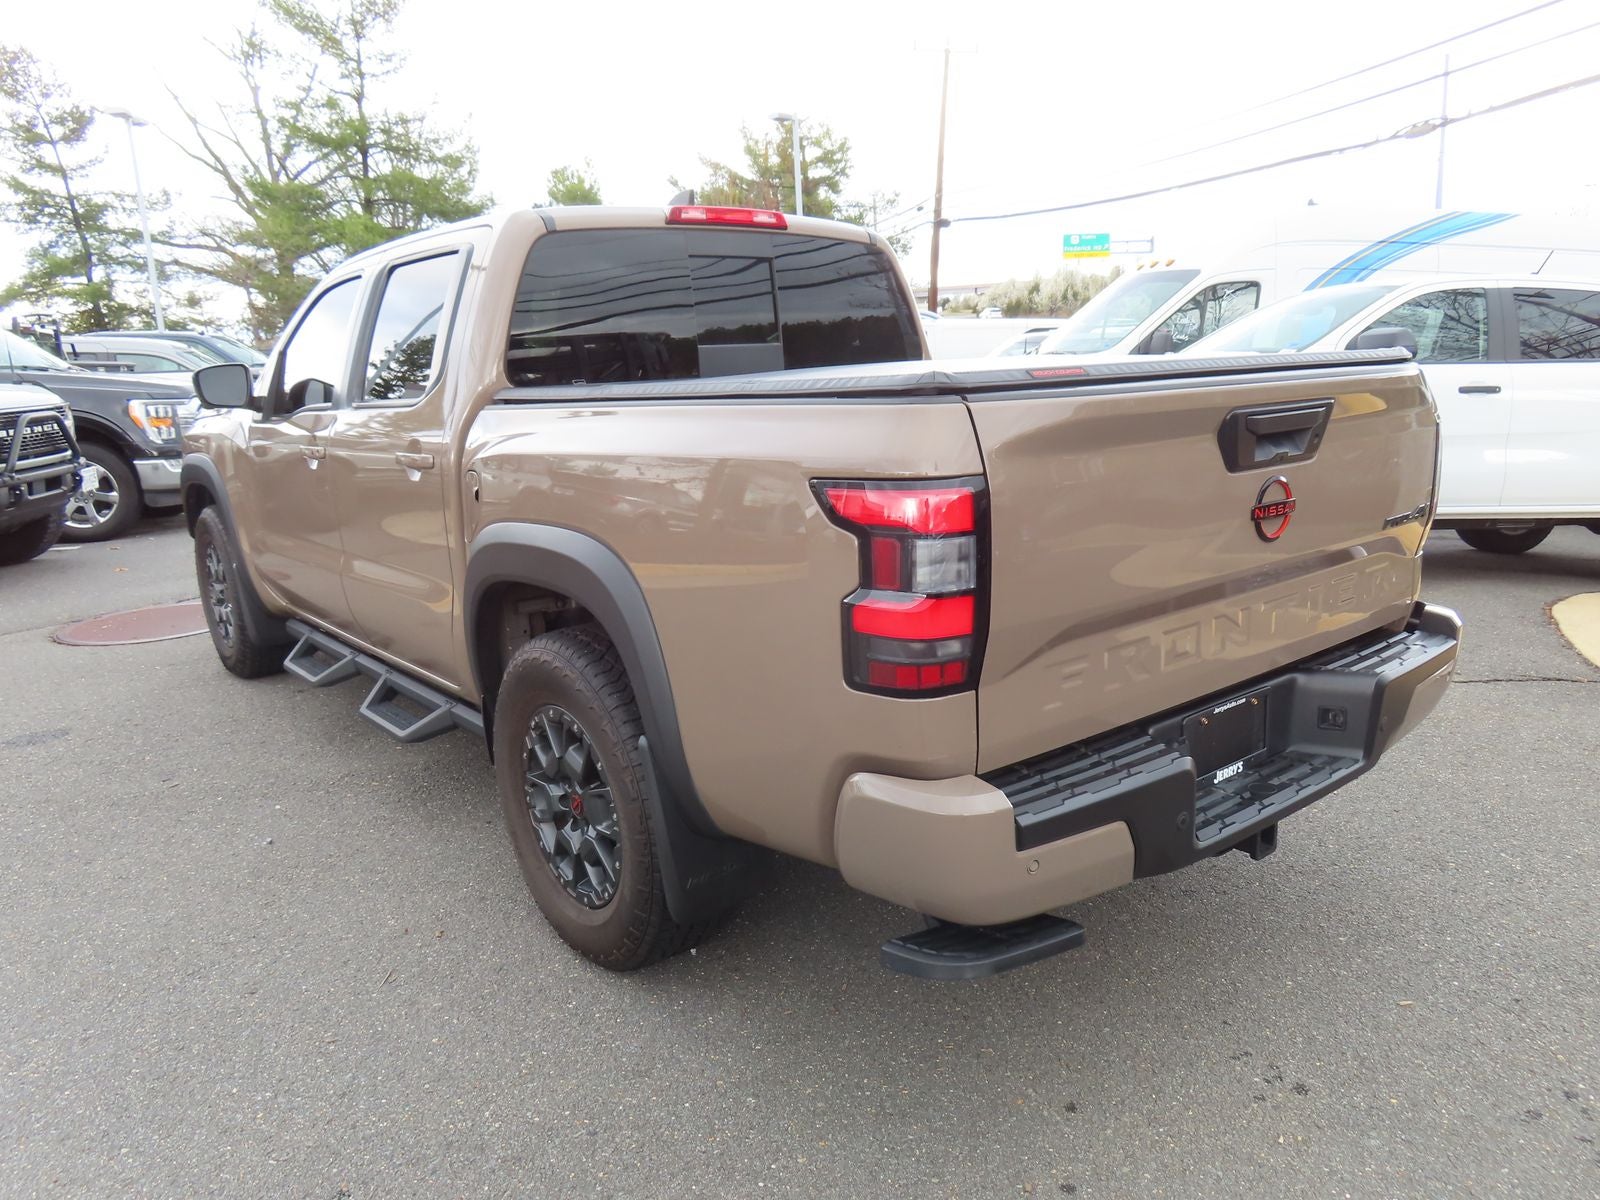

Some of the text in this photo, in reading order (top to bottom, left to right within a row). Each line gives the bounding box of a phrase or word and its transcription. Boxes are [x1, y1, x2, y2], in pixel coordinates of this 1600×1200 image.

[1255, 503, 1294, 519] NISSAN
[1043, 562, 1398, 710] FRONTIER
[1213, 761, 1244, 784] JERRY'S
